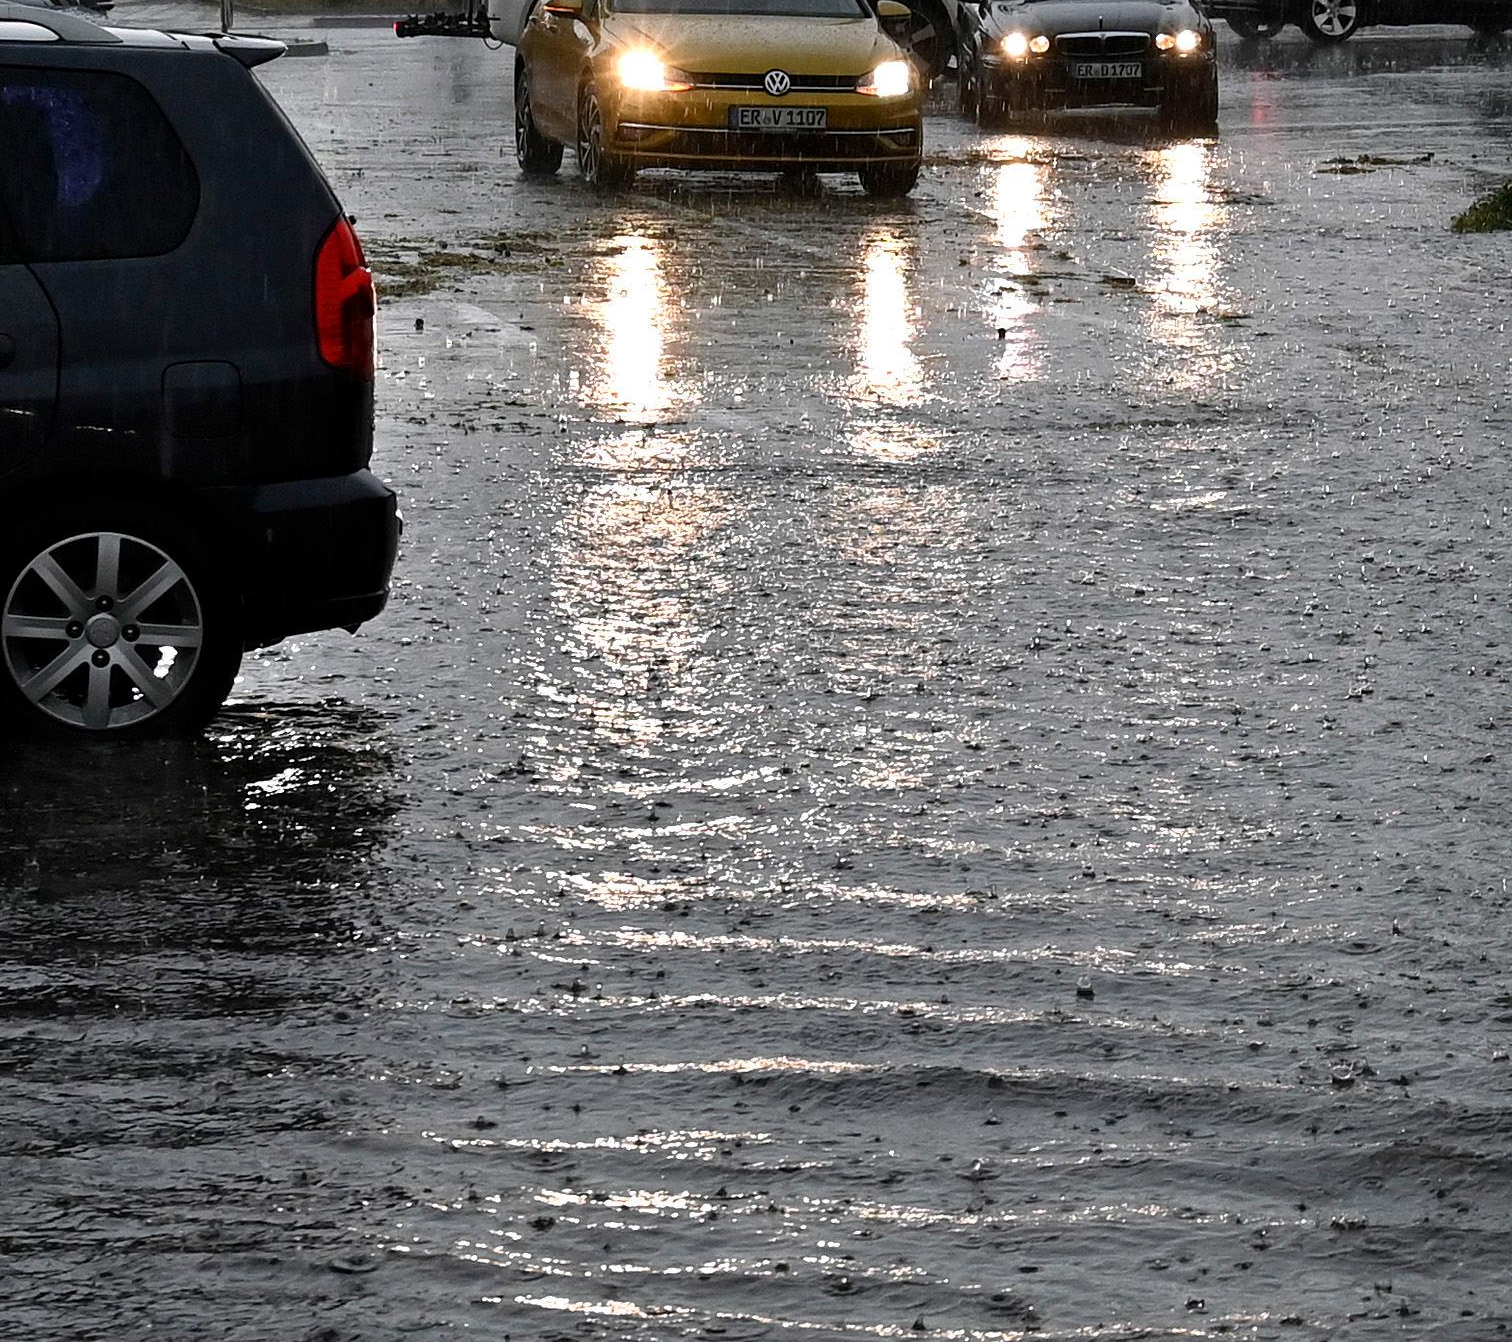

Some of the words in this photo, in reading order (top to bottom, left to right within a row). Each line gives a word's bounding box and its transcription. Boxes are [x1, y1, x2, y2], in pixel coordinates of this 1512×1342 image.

[1078, 65, 1093, 77] ER
[740, 109, 760, 125] ER
[772, 109, 782, 125] V
[786, 110, 826, 126] 1107
